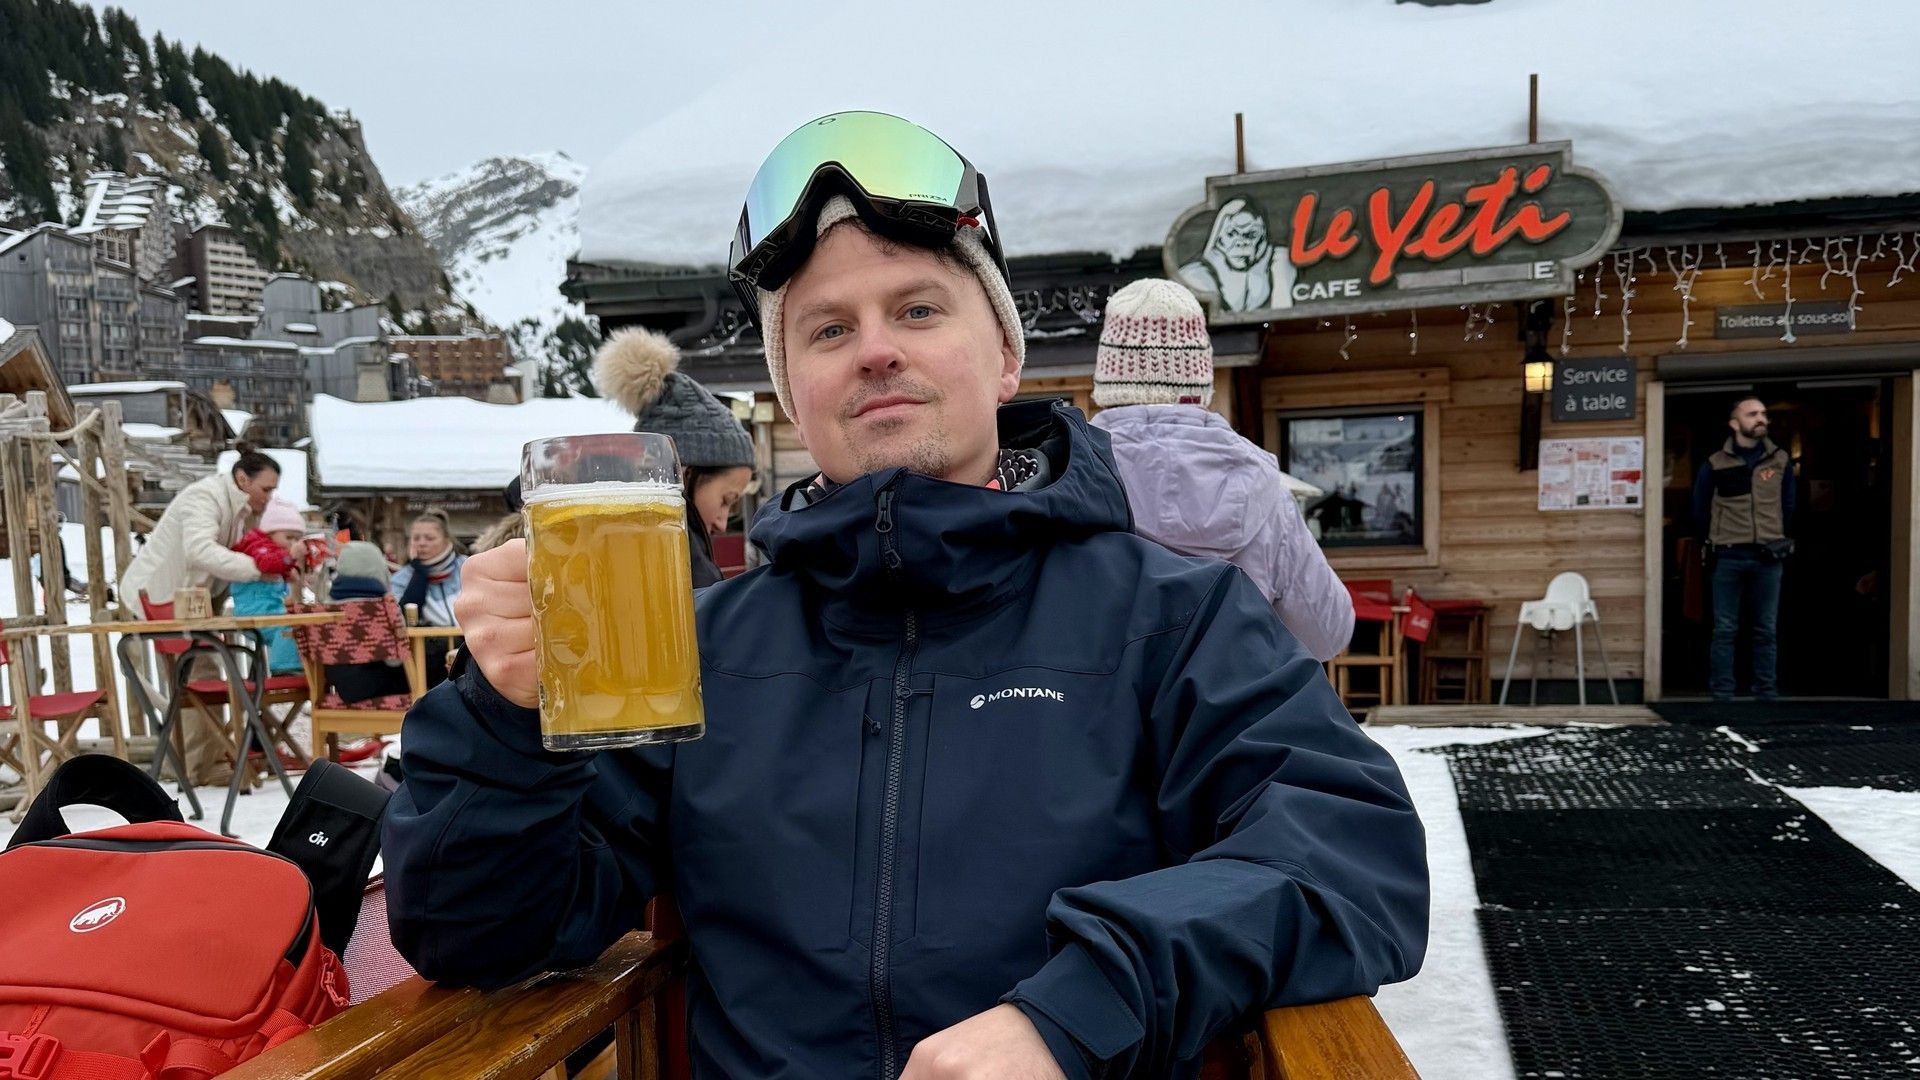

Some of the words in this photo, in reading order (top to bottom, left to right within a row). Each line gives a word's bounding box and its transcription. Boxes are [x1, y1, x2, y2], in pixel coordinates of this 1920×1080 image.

[1289, 193, 1359, 265] Le
[1369, 165, 1571, 284] Yeti
[1292, 279, 1362, 301] CAFE
[1719, 314, 1775, 328] Toilettes
[1562, 366, 1628, 386] Service
[1564, 394, 1577, 412] à
[1582, 393, 1627, 411] table
[988, 686, 1065, 703] MONTANE
